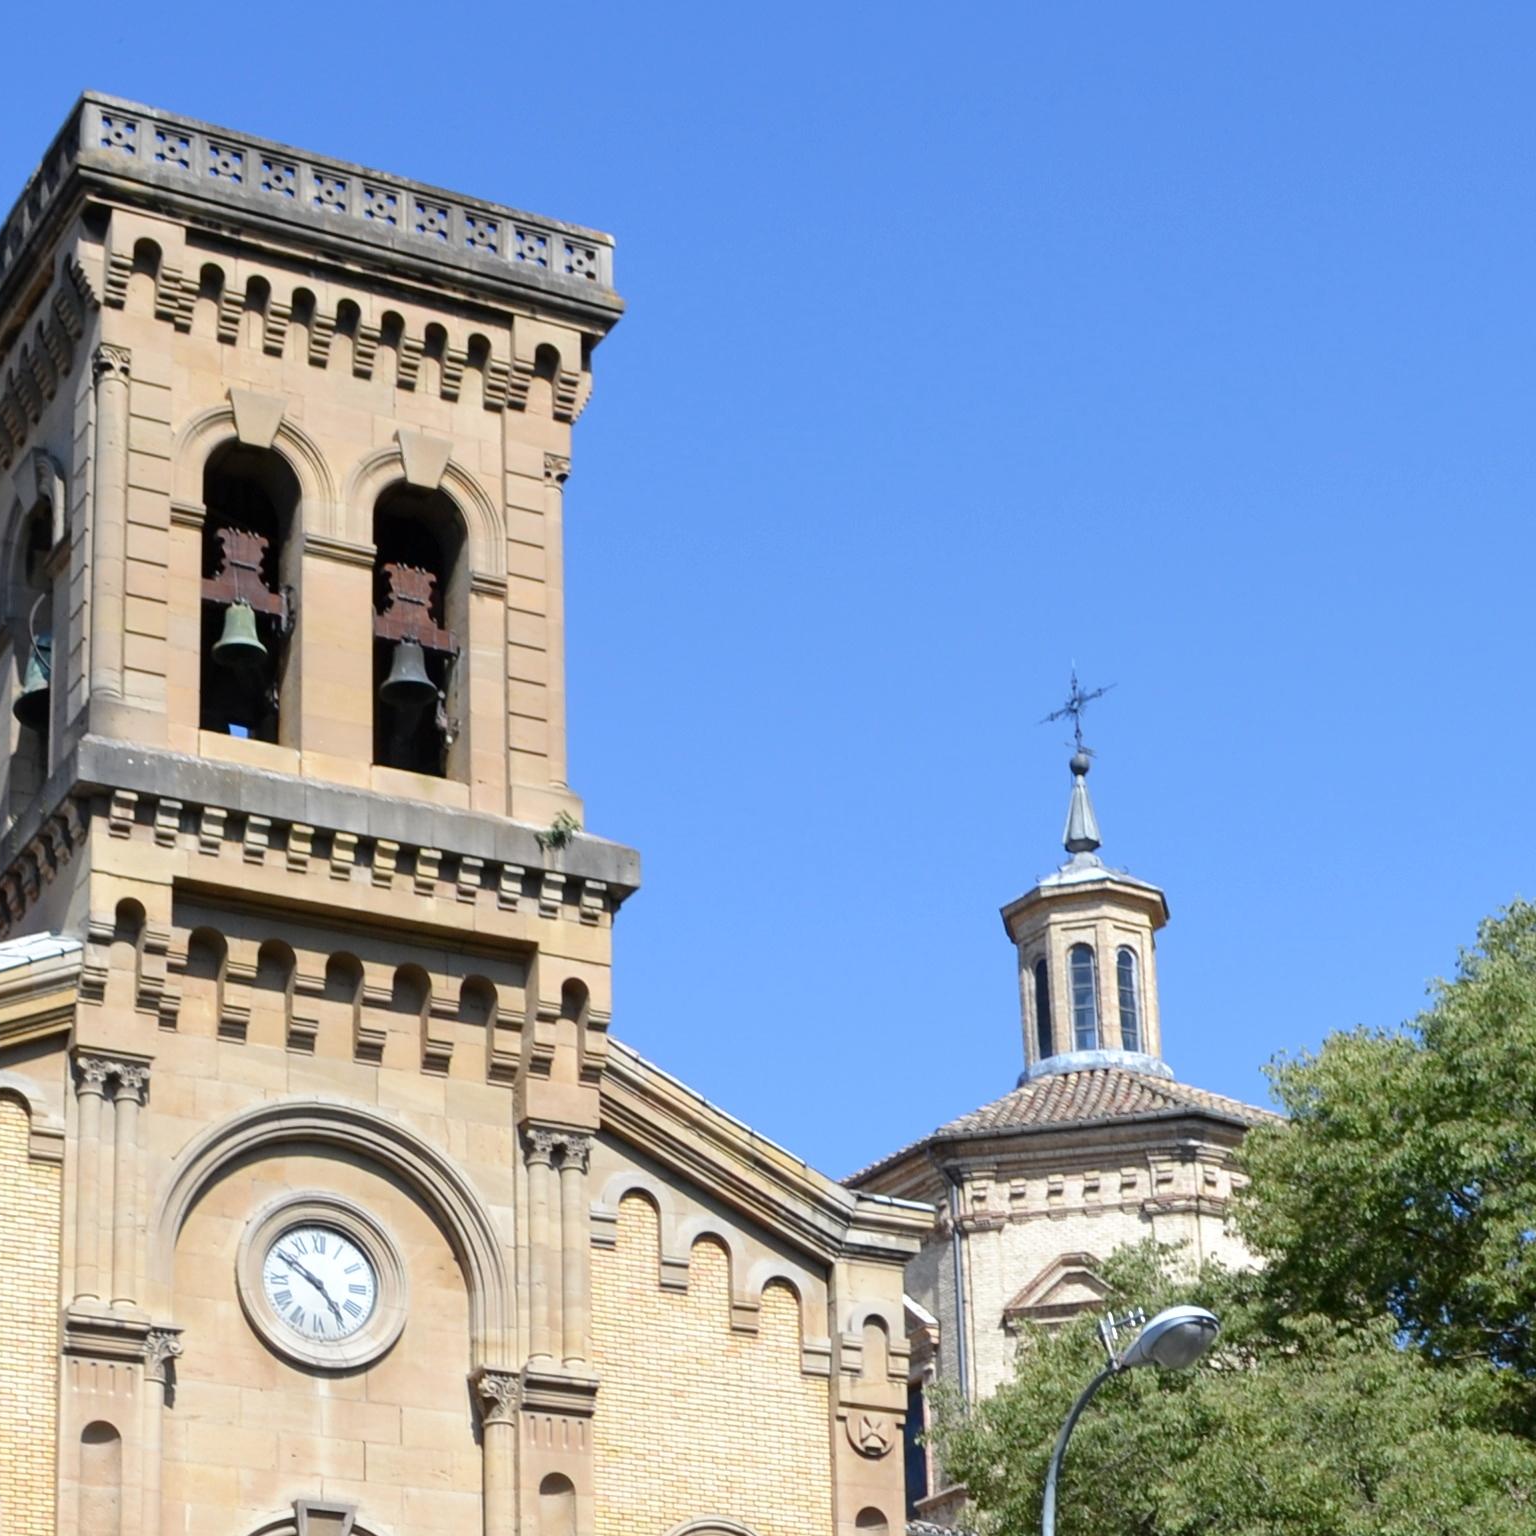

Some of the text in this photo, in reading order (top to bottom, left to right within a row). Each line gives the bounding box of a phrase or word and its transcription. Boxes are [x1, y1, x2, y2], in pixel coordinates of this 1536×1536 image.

[291, 1236, 308, 1255] XI
[312, 1233, 326, 1255] XII
[333, 1244, 343, 1260] I
[344, 1262, 362, 1274] II
[270, 1272, 289, 1285] IX
[348, 1284, 367, 1295] III
[273, 1290, 293, 1311] VIII
[289, 1305, 306, 1328] VII
[313, 1313, 325, 1333] VI
